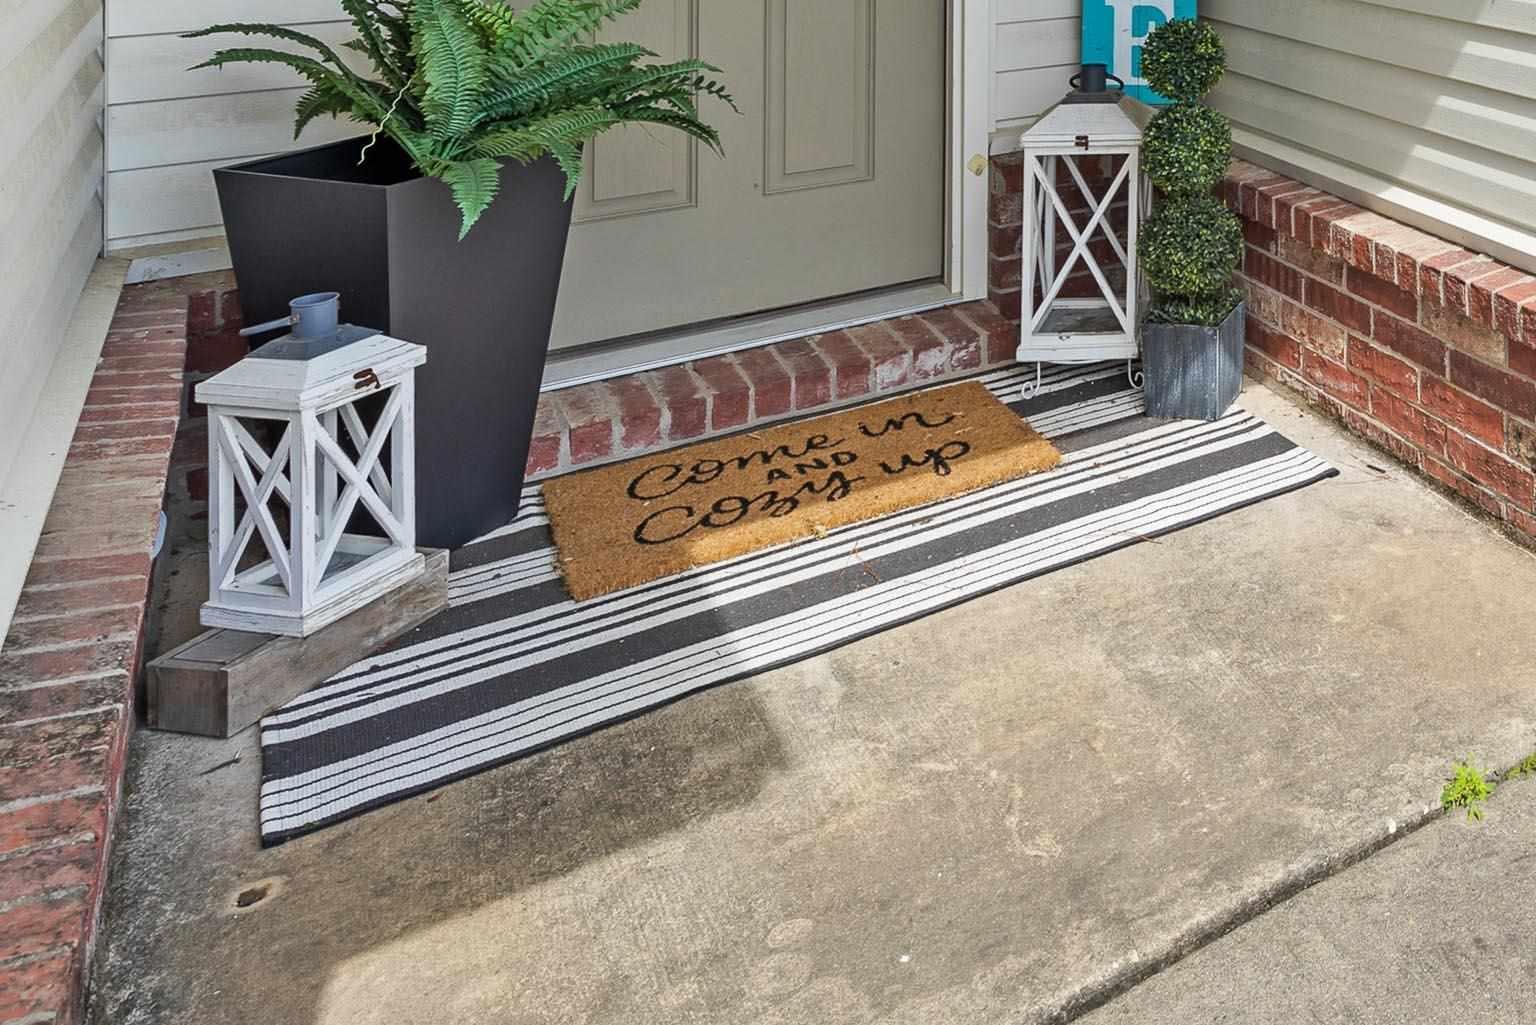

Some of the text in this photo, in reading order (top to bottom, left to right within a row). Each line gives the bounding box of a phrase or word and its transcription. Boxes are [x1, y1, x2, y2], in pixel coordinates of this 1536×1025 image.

[626, 410, 958, 501] Come in
[633, 438, 971, 546] Cozy up
[767, 451, 857, 484] AND
